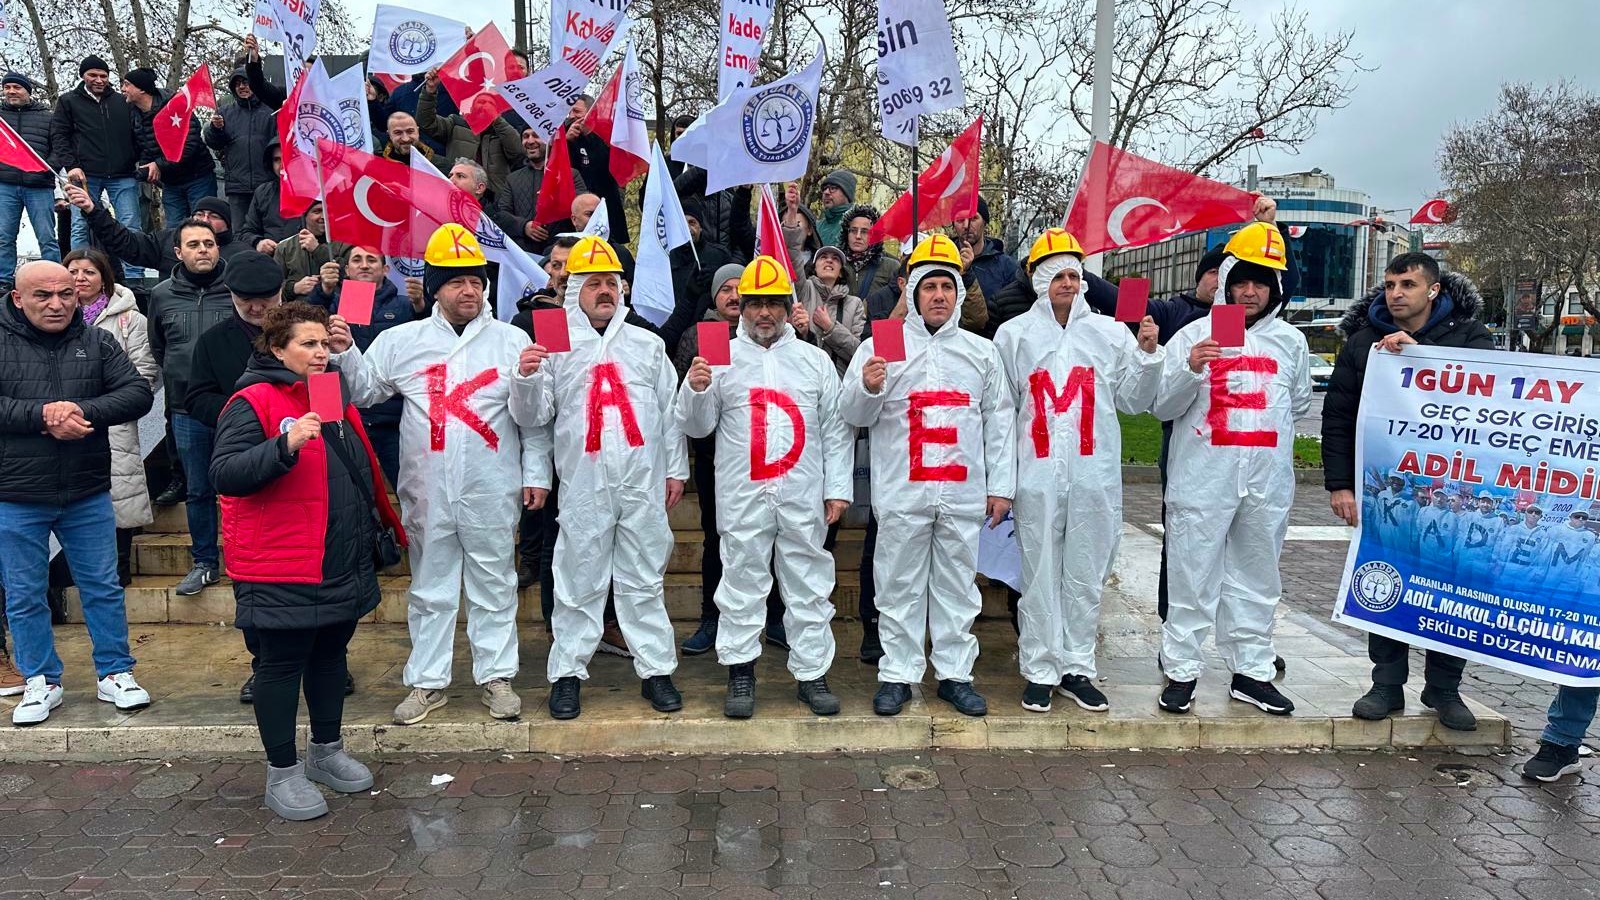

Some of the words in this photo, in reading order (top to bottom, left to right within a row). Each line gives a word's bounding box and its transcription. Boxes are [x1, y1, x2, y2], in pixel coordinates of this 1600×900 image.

[928, 77, 953, 99] 32
[451, 229, 476, 259] K
[588, 239, 614, 265] A
[928, 234, 949, 258] E
[1265, 227, 1282, 260] E
[754, 260, 780, 289] D
[1207, 355, 1279, 448] E
[1400, 363, 1497, 398] 1GÜN
[1509, 376, 1584, 404] 1AY
[420, 362, 499, 452] K
[585, 361, 645, 456] A
[1029, 365, 1095, 458] M
[1420, 402, 1471, 425] GEÇ
[1475, 408, 1526, 428] SGK
[1532, 411, 1600, 441] GİRİŞ
[749, 387, 806, 481] D
[907, 391, 971, 482] E
[1387, 419, 1443, 441] 17-20
[1450, 428, 1481, 446] YIL
[1488, 431, 1541, 457] GEÇ
[1397, 450, 1484, 484] ADİL
[1495, 461, 1600, 500] MİDİ
[1409, 574, 1454, 593] AKRANLAR
[1455, 586, 1500, 606] ARASINDA
[1503, 597, 1545, 615] OLUŞAN
[1548, 607, 1580, 622] 17-20
[1418, 615, 1477, 643] ŞEKİLDE
